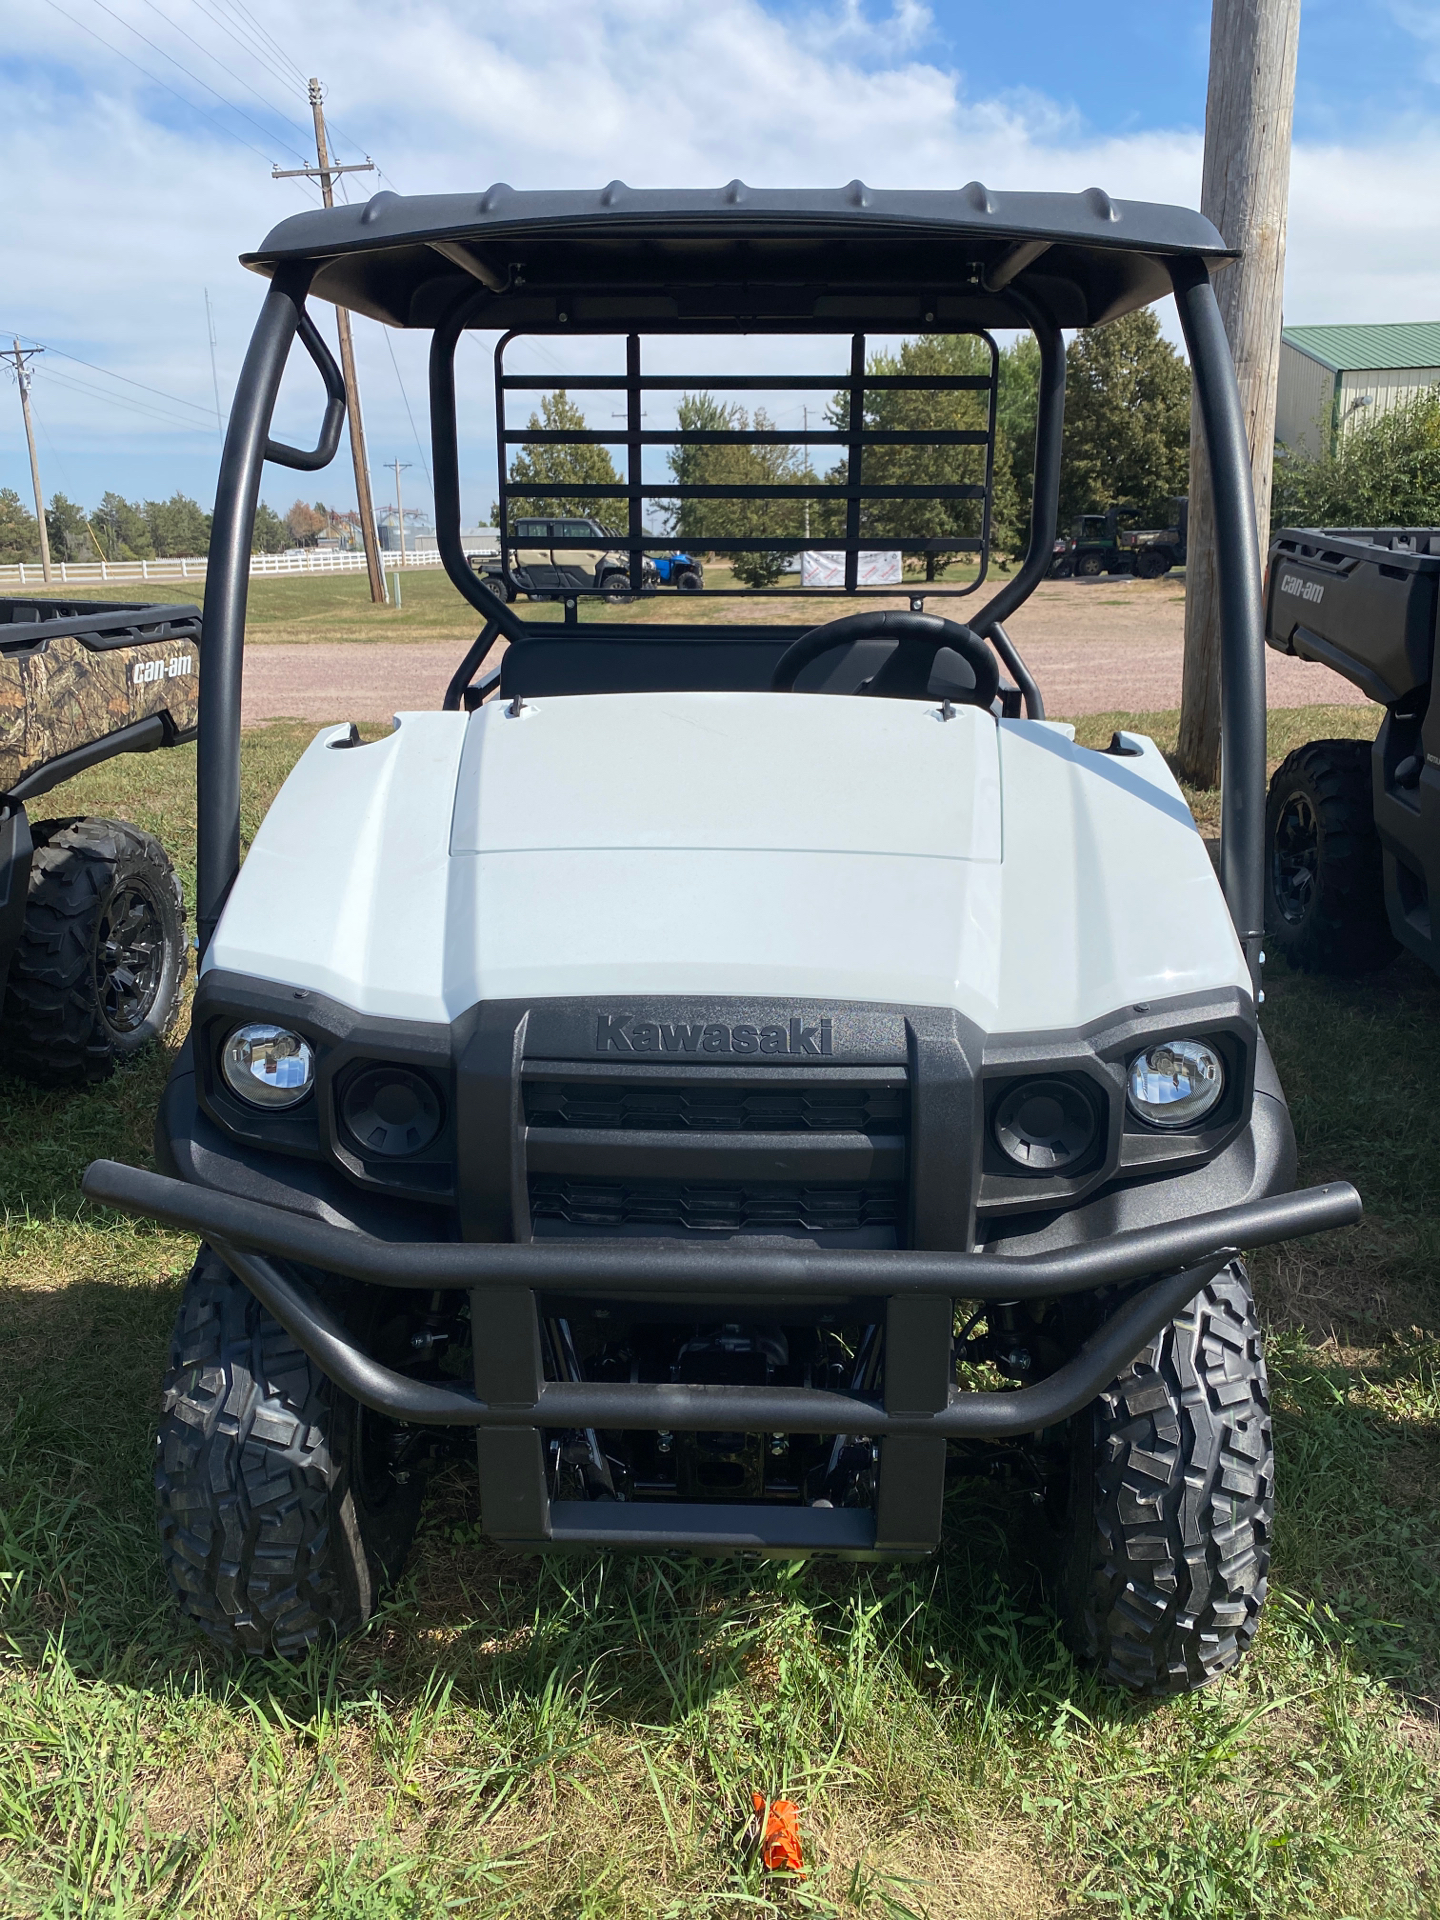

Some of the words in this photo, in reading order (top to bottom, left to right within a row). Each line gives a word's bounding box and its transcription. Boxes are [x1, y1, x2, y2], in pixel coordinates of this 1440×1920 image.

[1281, 574, 1325, 604] can-am
[133, 654, 192, 684] can-am
[596, 1014, 833, 1055] Kawasaki
